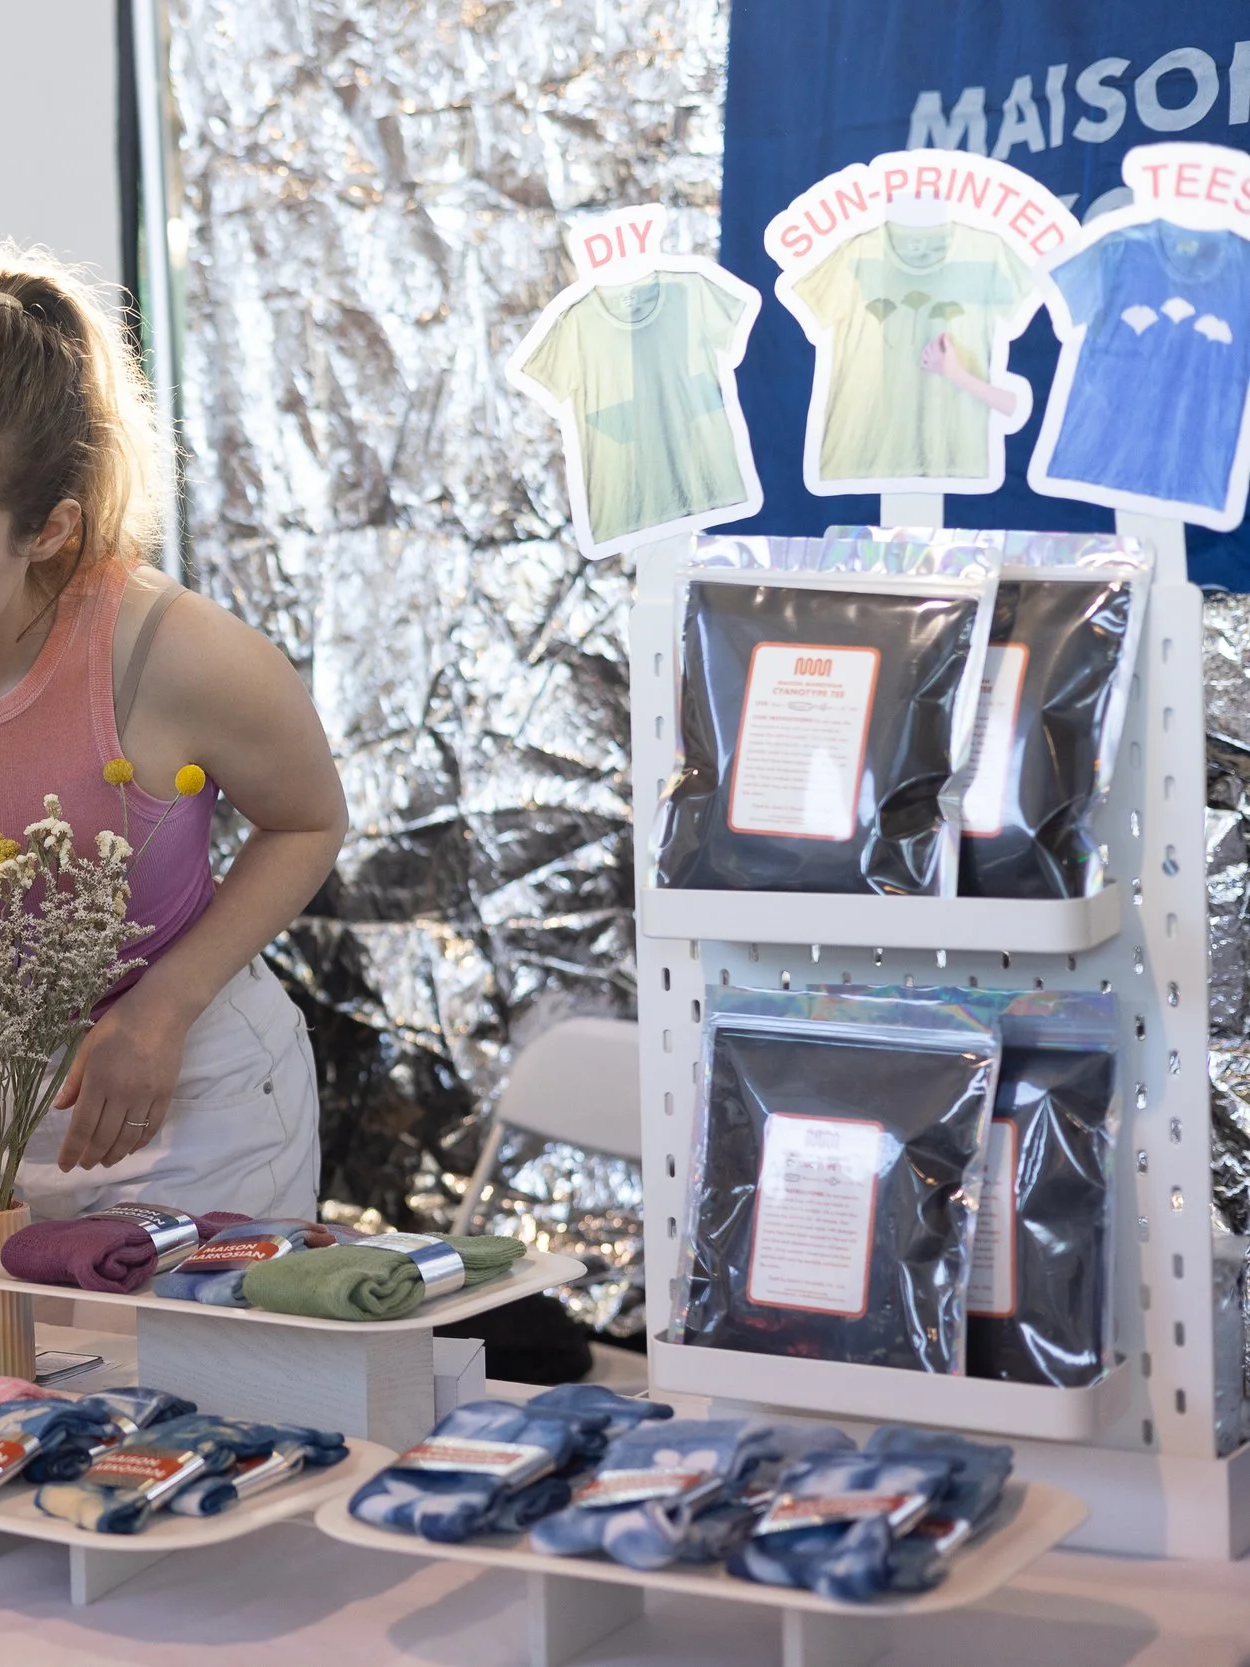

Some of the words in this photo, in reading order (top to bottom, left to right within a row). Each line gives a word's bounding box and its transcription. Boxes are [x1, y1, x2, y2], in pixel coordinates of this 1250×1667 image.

[780, 166, 1065, 258] SUN-PRINTED
[583, 220, 653, 269] DIY
[104, 1210, 166, 1225] ARKOSIAN
[203, 1243, 258, 1254] MAISON
